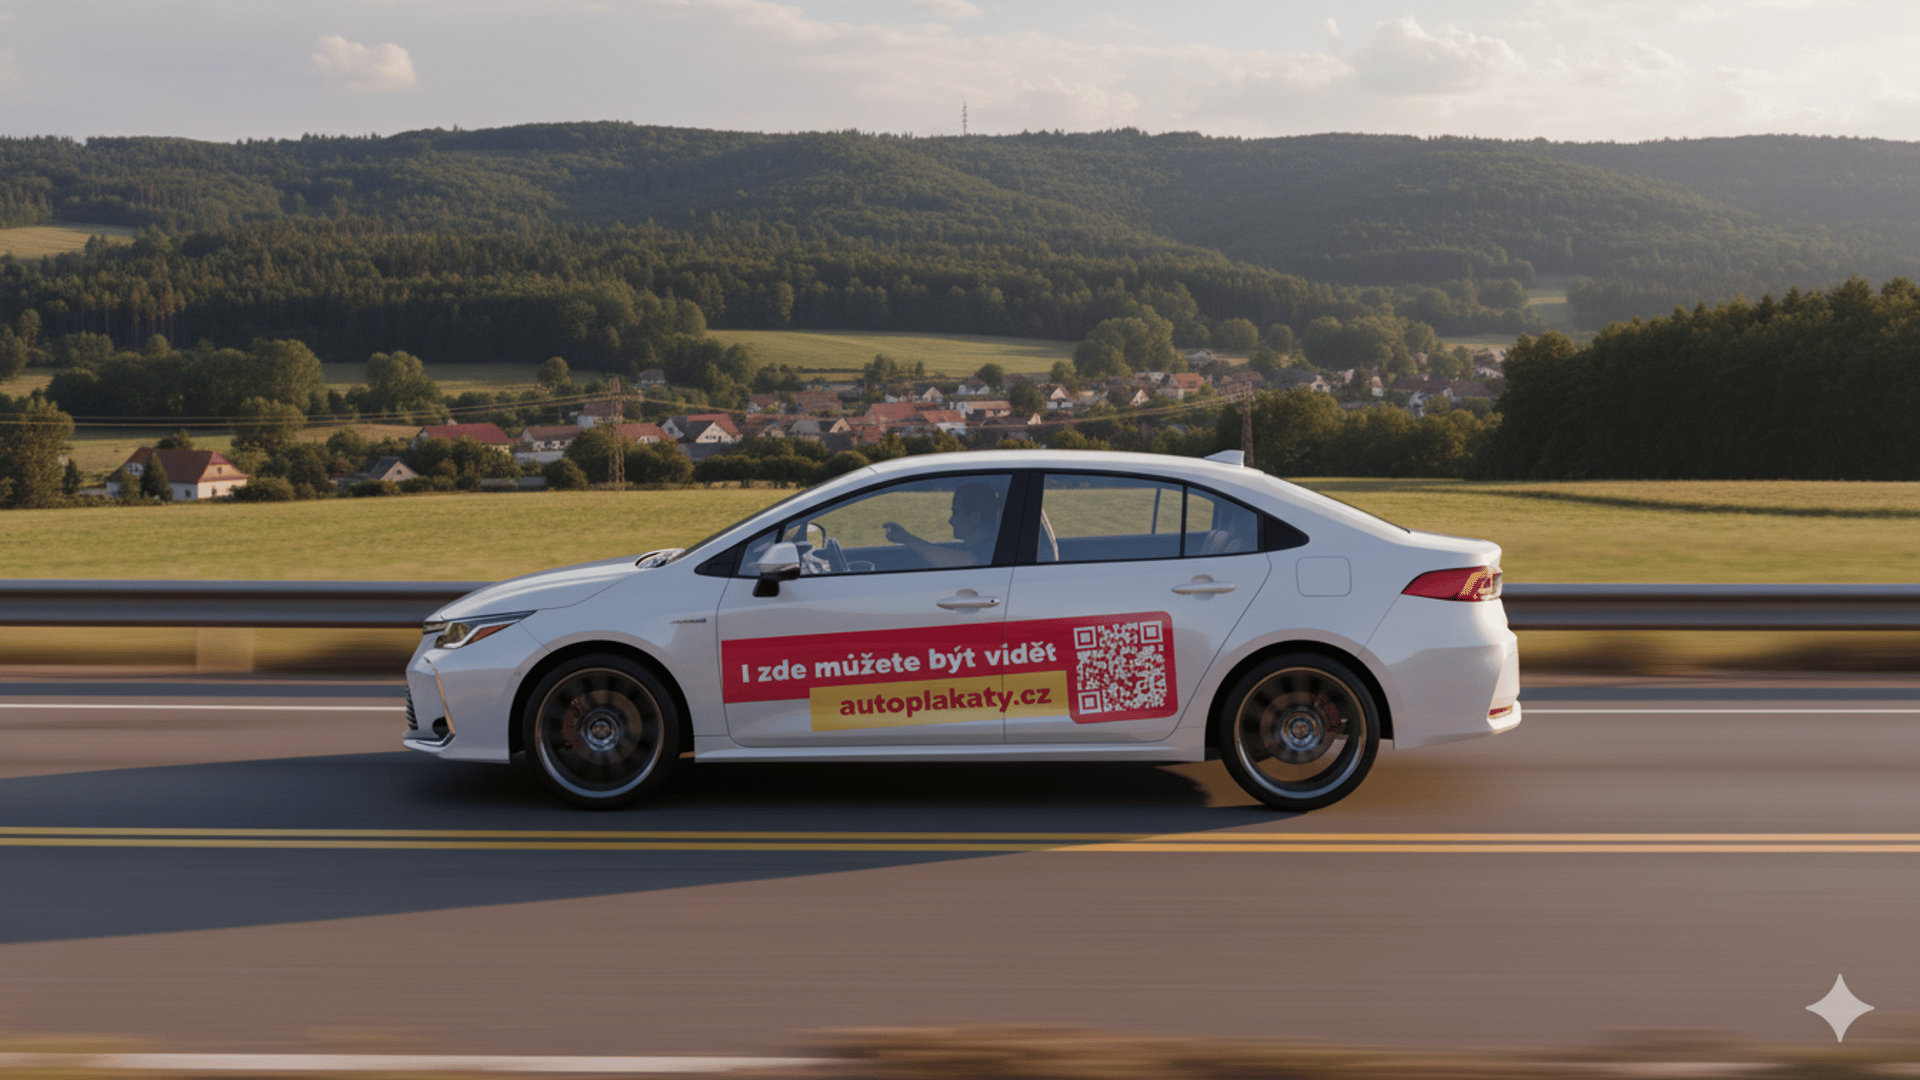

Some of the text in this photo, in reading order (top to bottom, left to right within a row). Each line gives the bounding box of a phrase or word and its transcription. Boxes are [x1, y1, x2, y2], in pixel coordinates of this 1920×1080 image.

[741, 664, 750, 683] I
[757, 659, 807, 682] zde
[928, 645, 976, 674] být
[839, 685, 1052, 719] autoplakaty.cz
